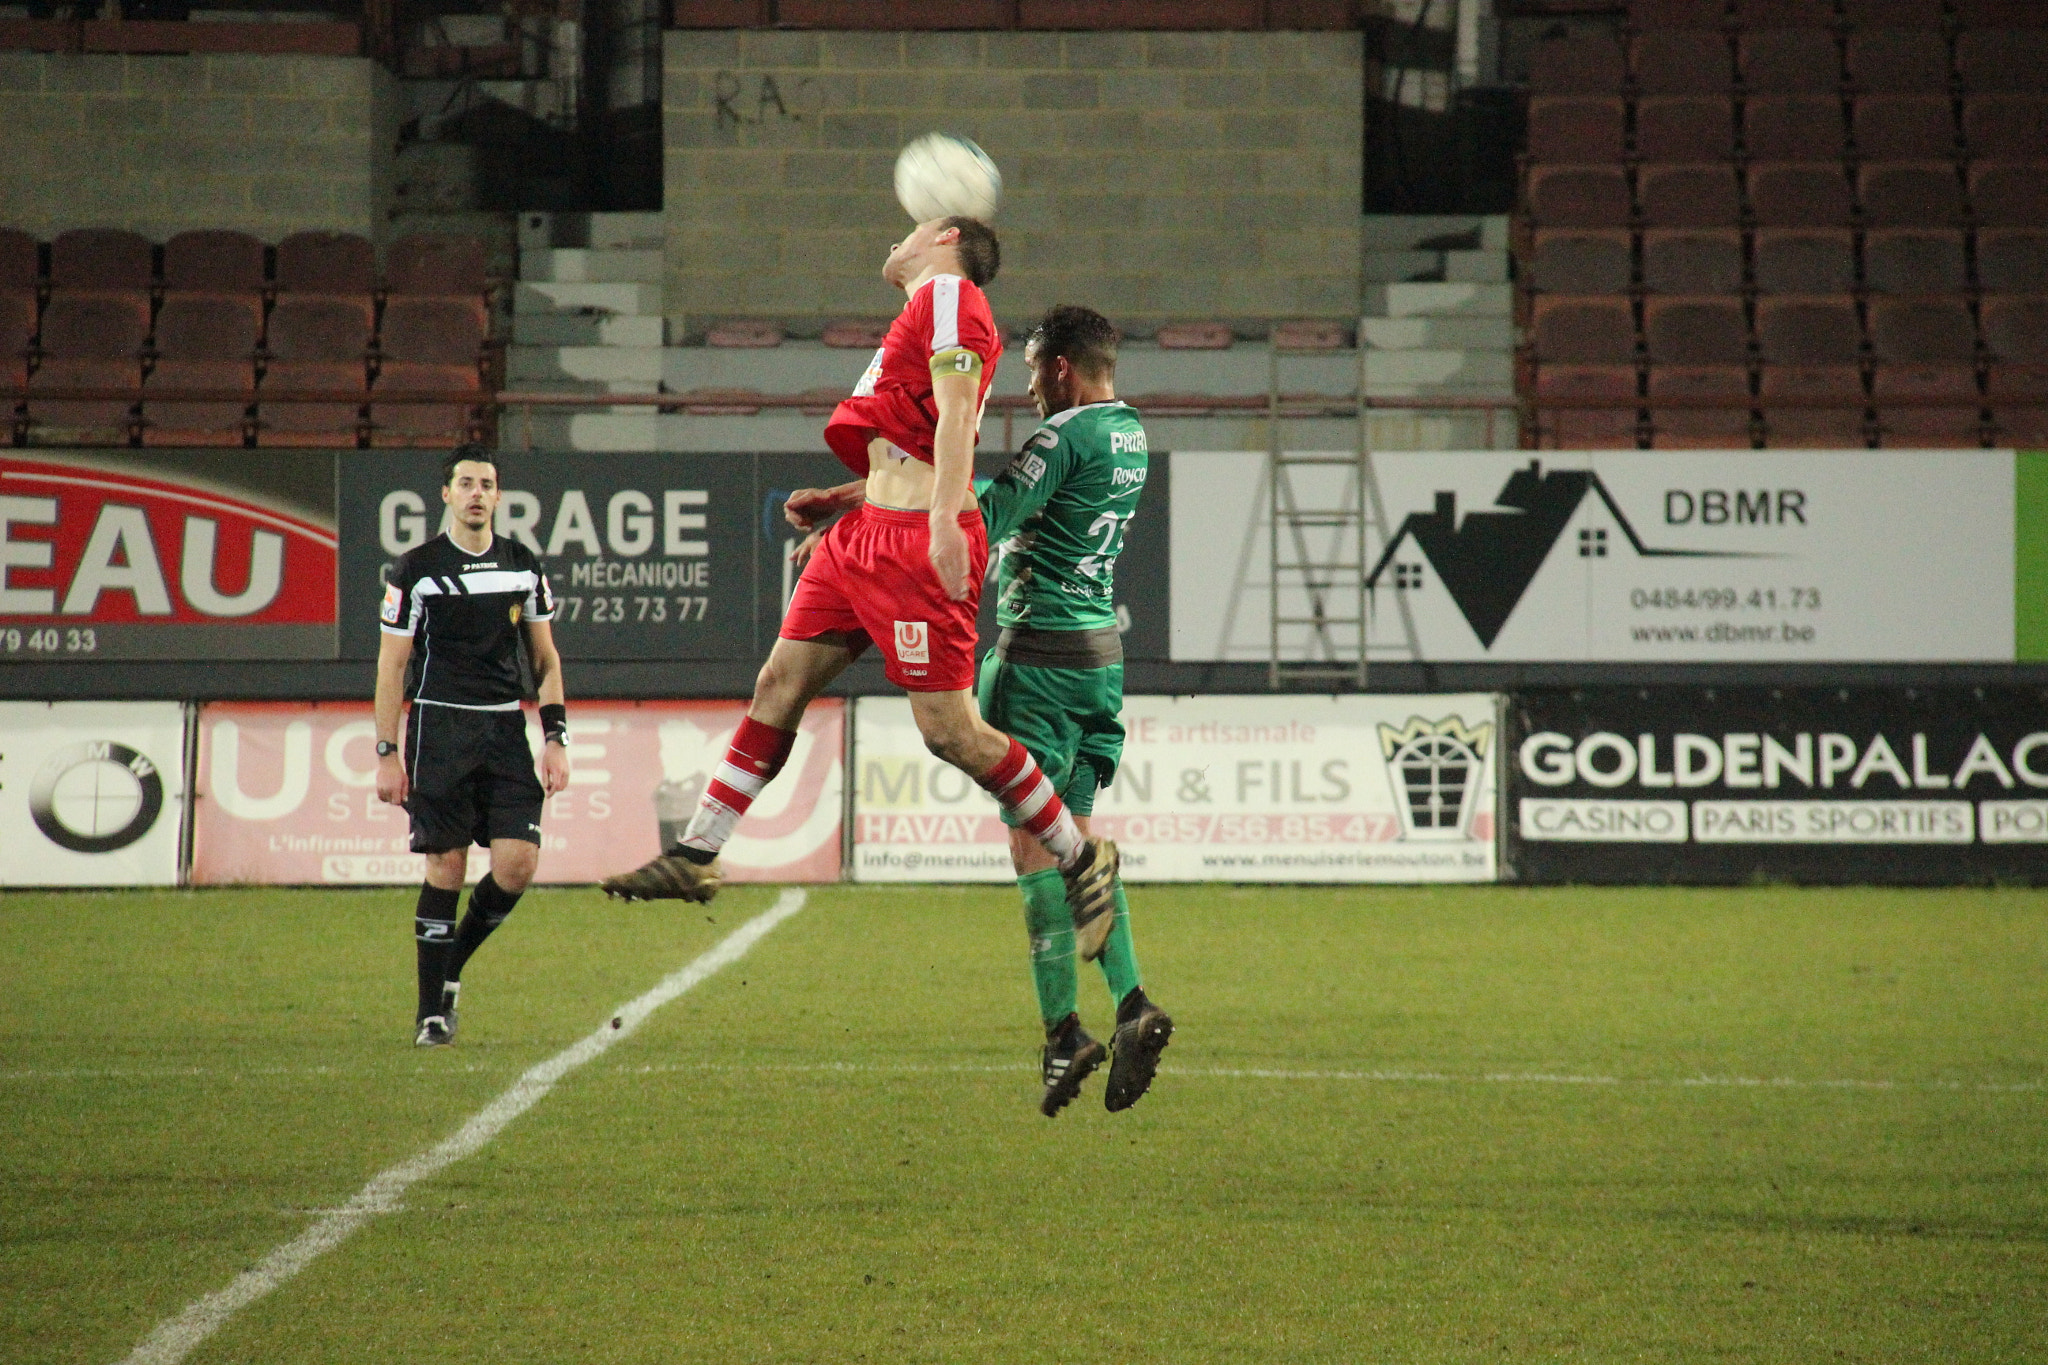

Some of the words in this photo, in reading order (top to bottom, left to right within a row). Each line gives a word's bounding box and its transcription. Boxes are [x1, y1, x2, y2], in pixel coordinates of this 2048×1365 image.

[1664, 490, 1808, 526] DBMR
[379, 490, 709, 556] GRAGE
[571, 556, 709, 588] MÉCANIQUE
[592, 597, 623, 621] 23
[636, 597, 667, 621] 73
[677, 597, 709, 621] 77
[28, 629, 59, 651] 40
[66, 629, 97, 651] 33
[1630, 622, 1816, 642] www.dbmr.be
[898, 650, 927, 658] UCARE
[1168, 722, 1316, 744] artisanale
[1176, 767, 1213, 803] &
[1235, 759, 1351, 804] FILS
[863, 816, 980, 843] HAVAY
[1532, 806, 1676, 835] CASINO
[1702, 807, 1796, 835] PARIS
[1807, 807, 1963, 836] SPORTIFS
